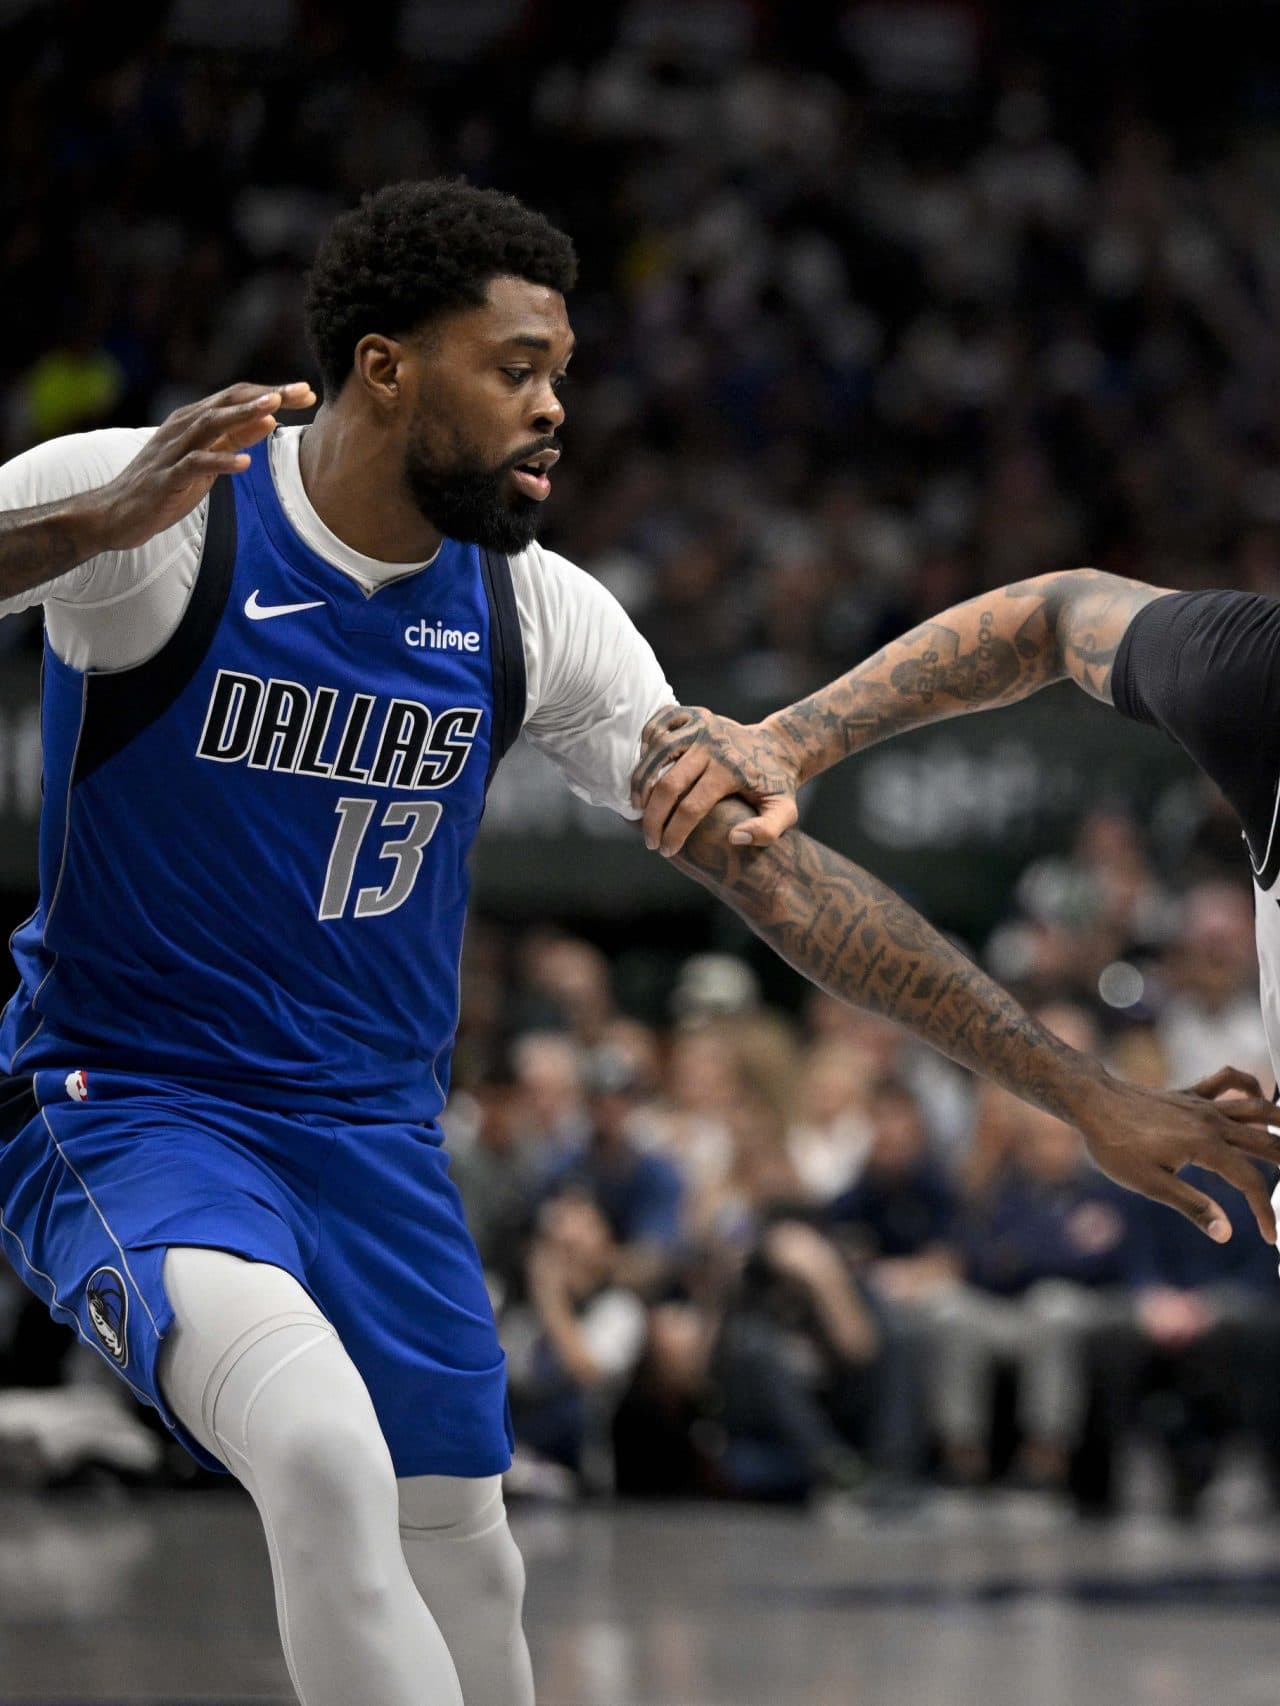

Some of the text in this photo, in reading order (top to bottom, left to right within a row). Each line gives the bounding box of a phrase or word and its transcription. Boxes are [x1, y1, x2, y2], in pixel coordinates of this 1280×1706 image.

[404, 618, 481, 652] chime
[195, 668, 484, 791] DALLAS
[317, 796, 444, 921] 13
